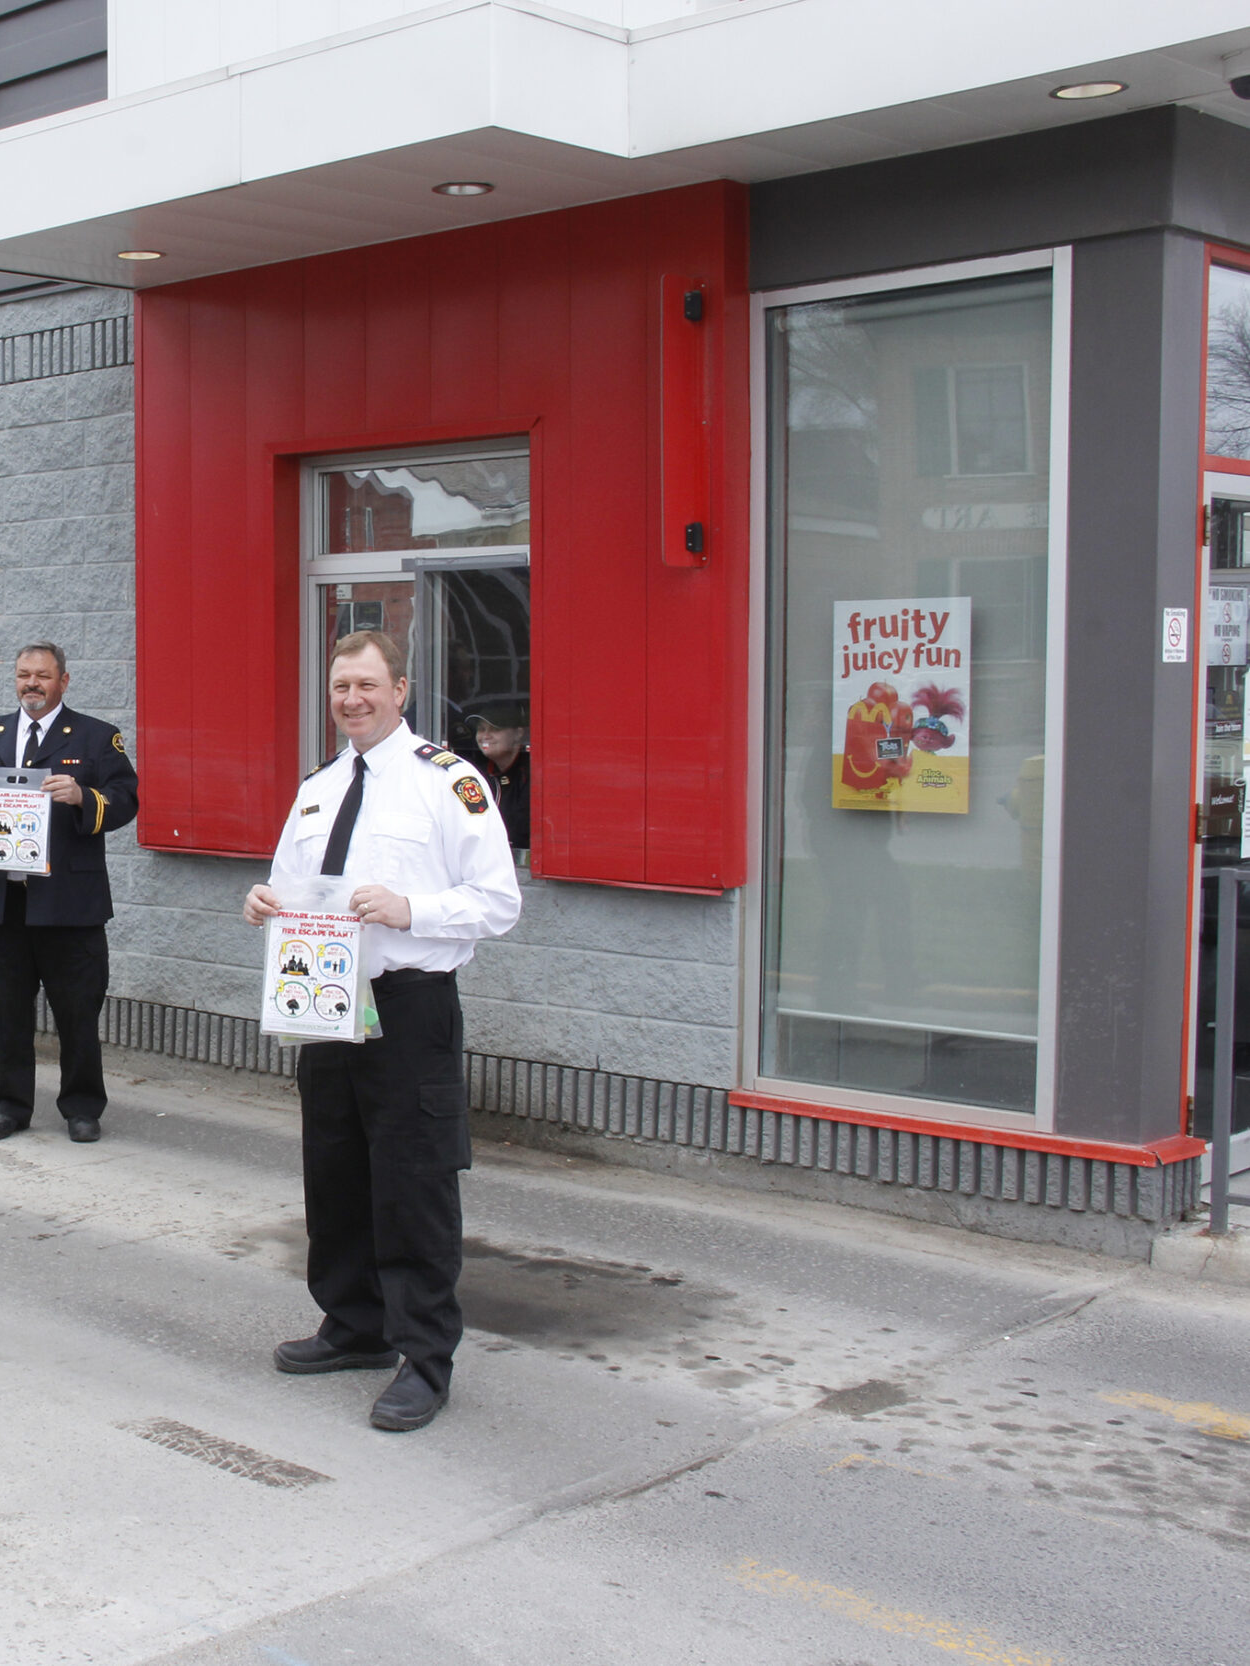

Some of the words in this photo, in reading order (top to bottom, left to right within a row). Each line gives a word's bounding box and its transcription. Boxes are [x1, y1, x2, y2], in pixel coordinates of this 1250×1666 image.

[848, 608, 950, 644] fruity
[841, 643, 908, 679] juicy
[912, 643, 961, 668] fun
[277, 910, 308, 919] PREPARE
[298, 928, 326, 937] ESCAPE
[328, 930, 348, 938] PLAN
